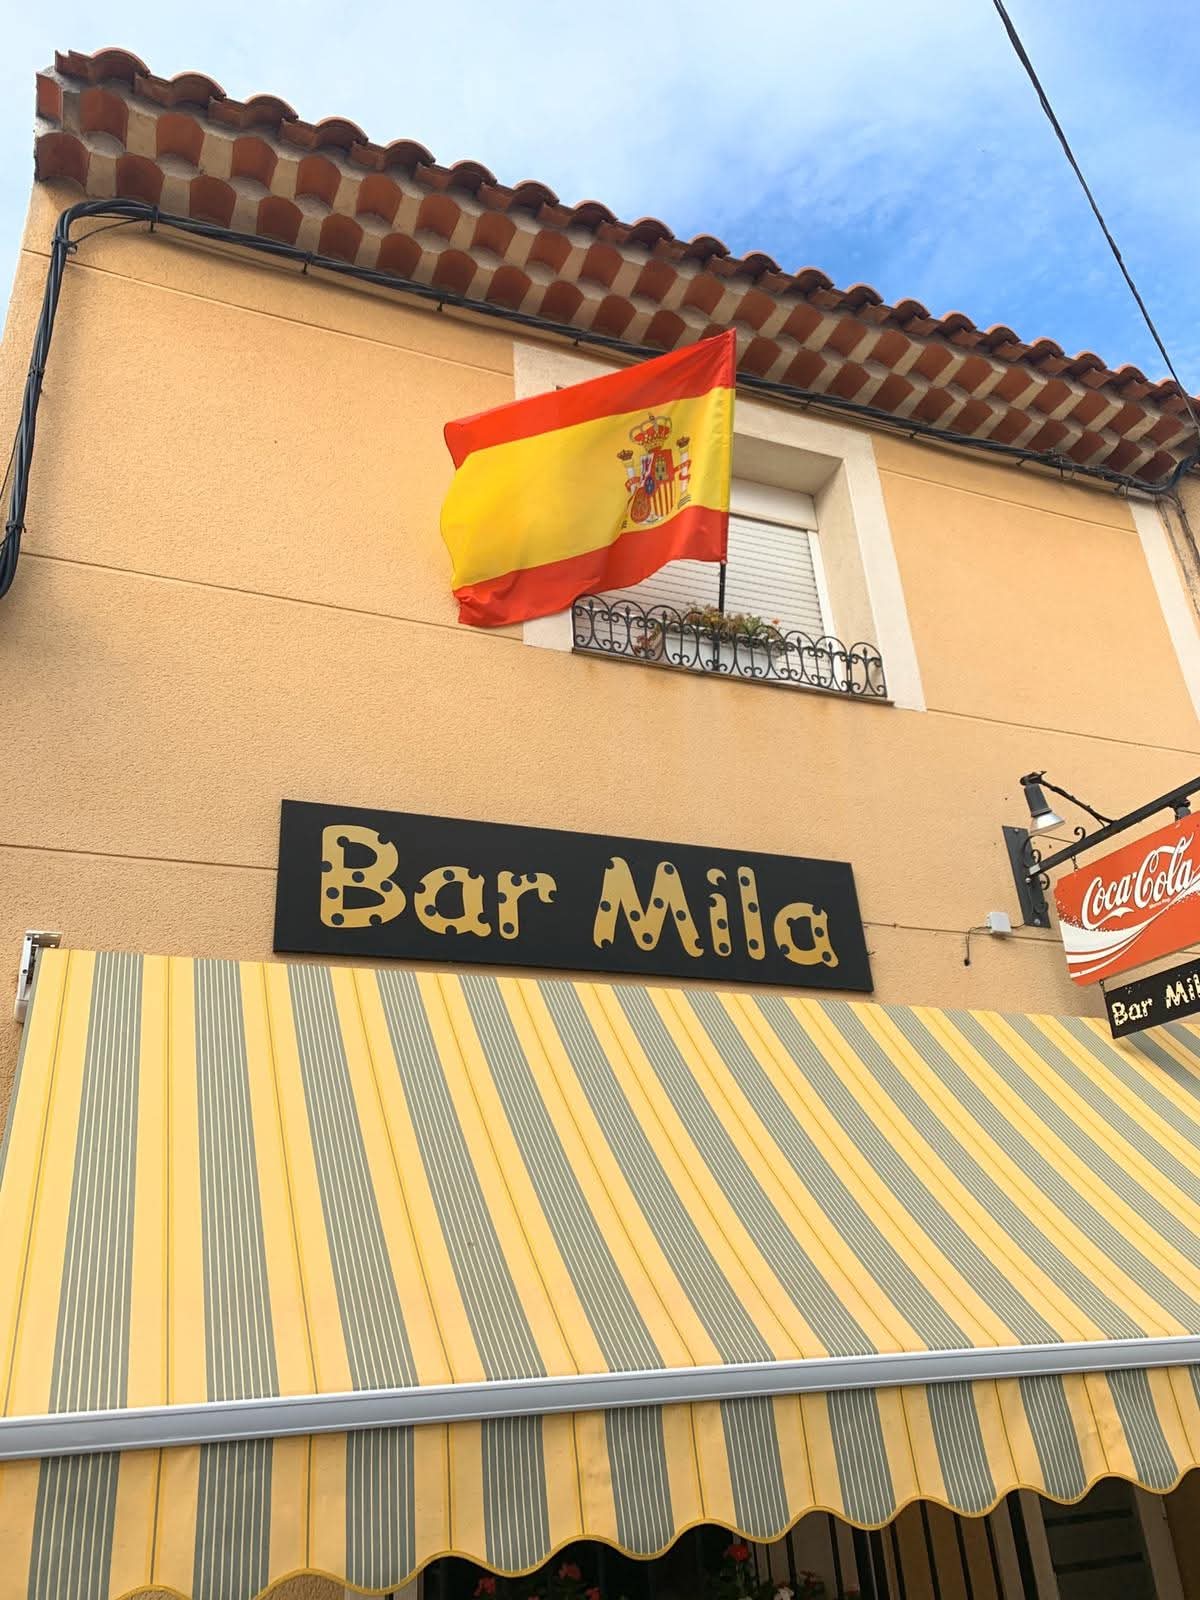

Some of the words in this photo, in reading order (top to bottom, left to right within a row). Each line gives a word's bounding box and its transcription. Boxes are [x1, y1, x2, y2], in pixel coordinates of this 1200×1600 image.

[320, 824, 557, 940] Bar
[593, 856, 839, 968] Mila
[1081, 832, 1194, 930] Coca-Cola
[1111, 998, 1153, 1027] Bar
